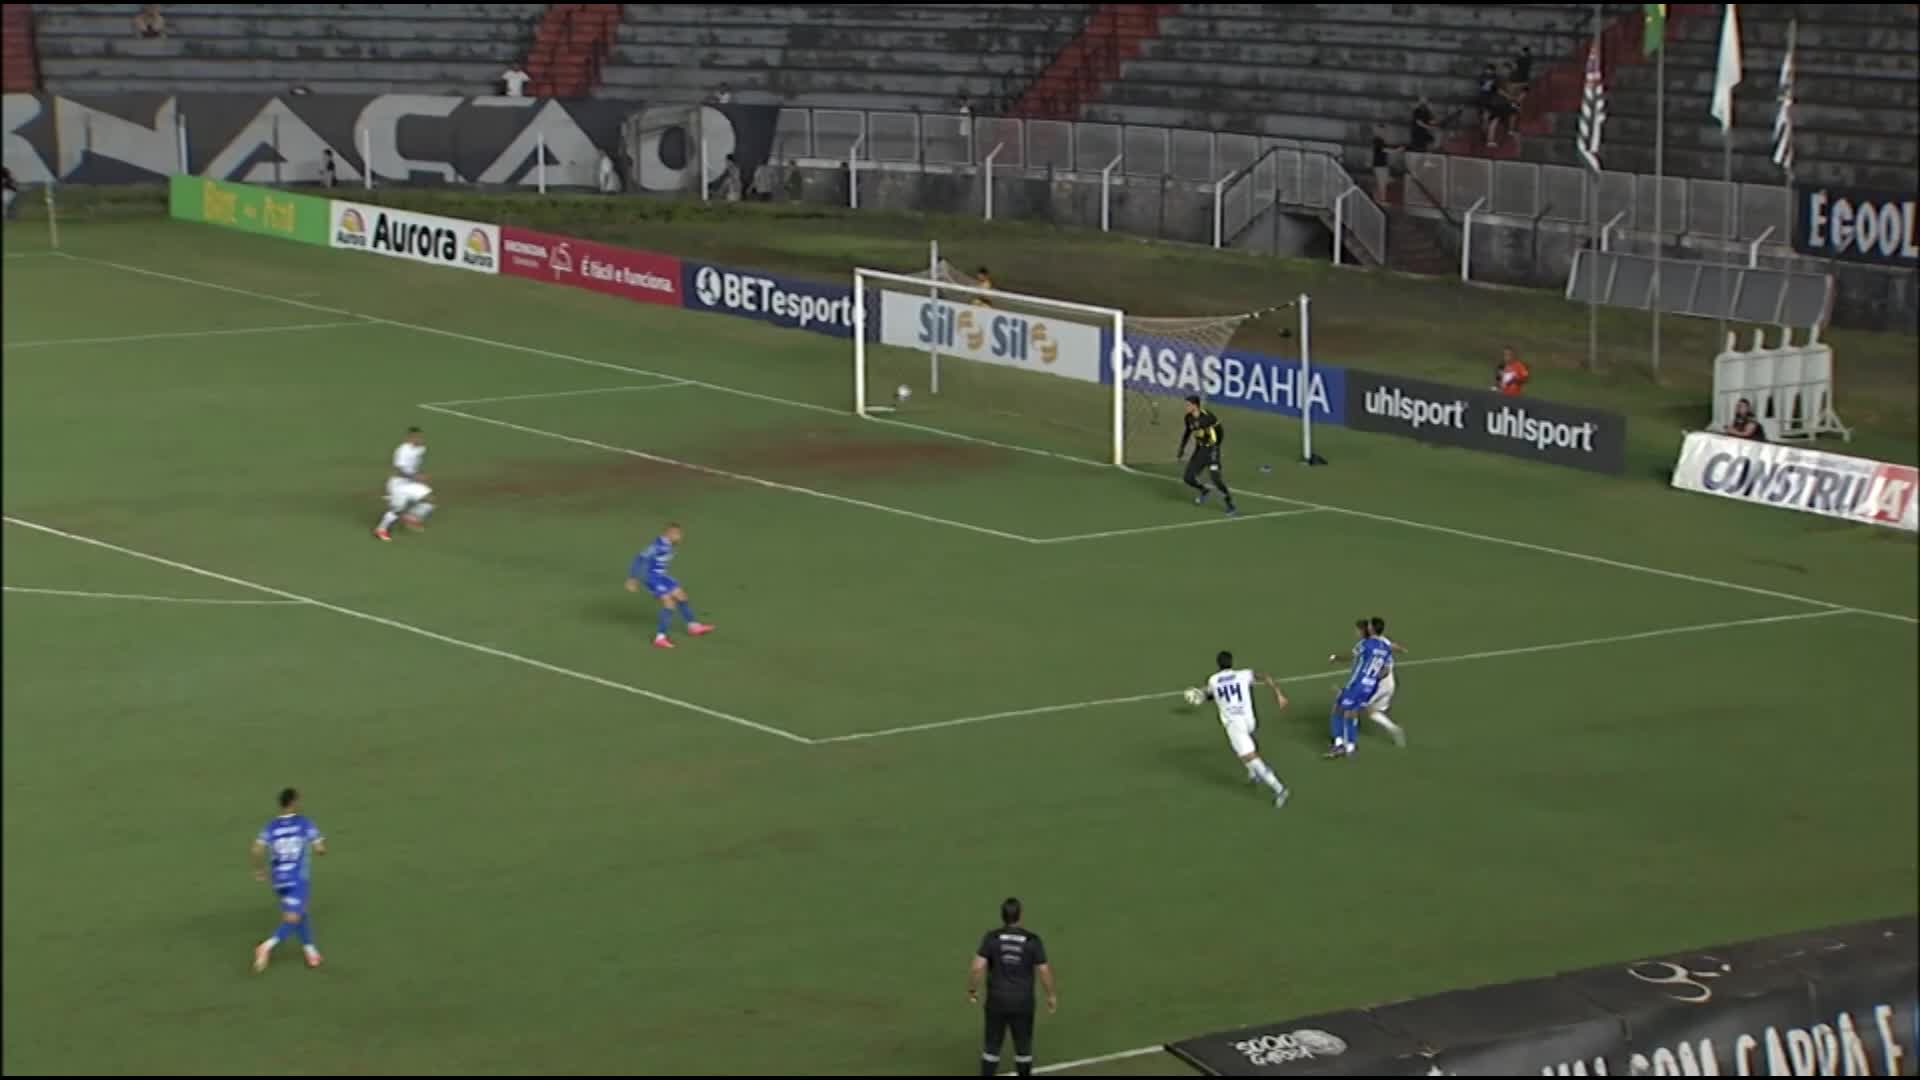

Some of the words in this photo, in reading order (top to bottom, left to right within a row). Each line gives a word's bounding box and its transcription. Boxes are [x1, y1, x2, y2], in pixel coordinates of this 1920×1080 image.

[373, 212, 457, 260] Aurora
[919, 303, 954, 348] Sil
[992, 315, 1027, 360] Sil
[1217, 683, 1242, 702] 44
